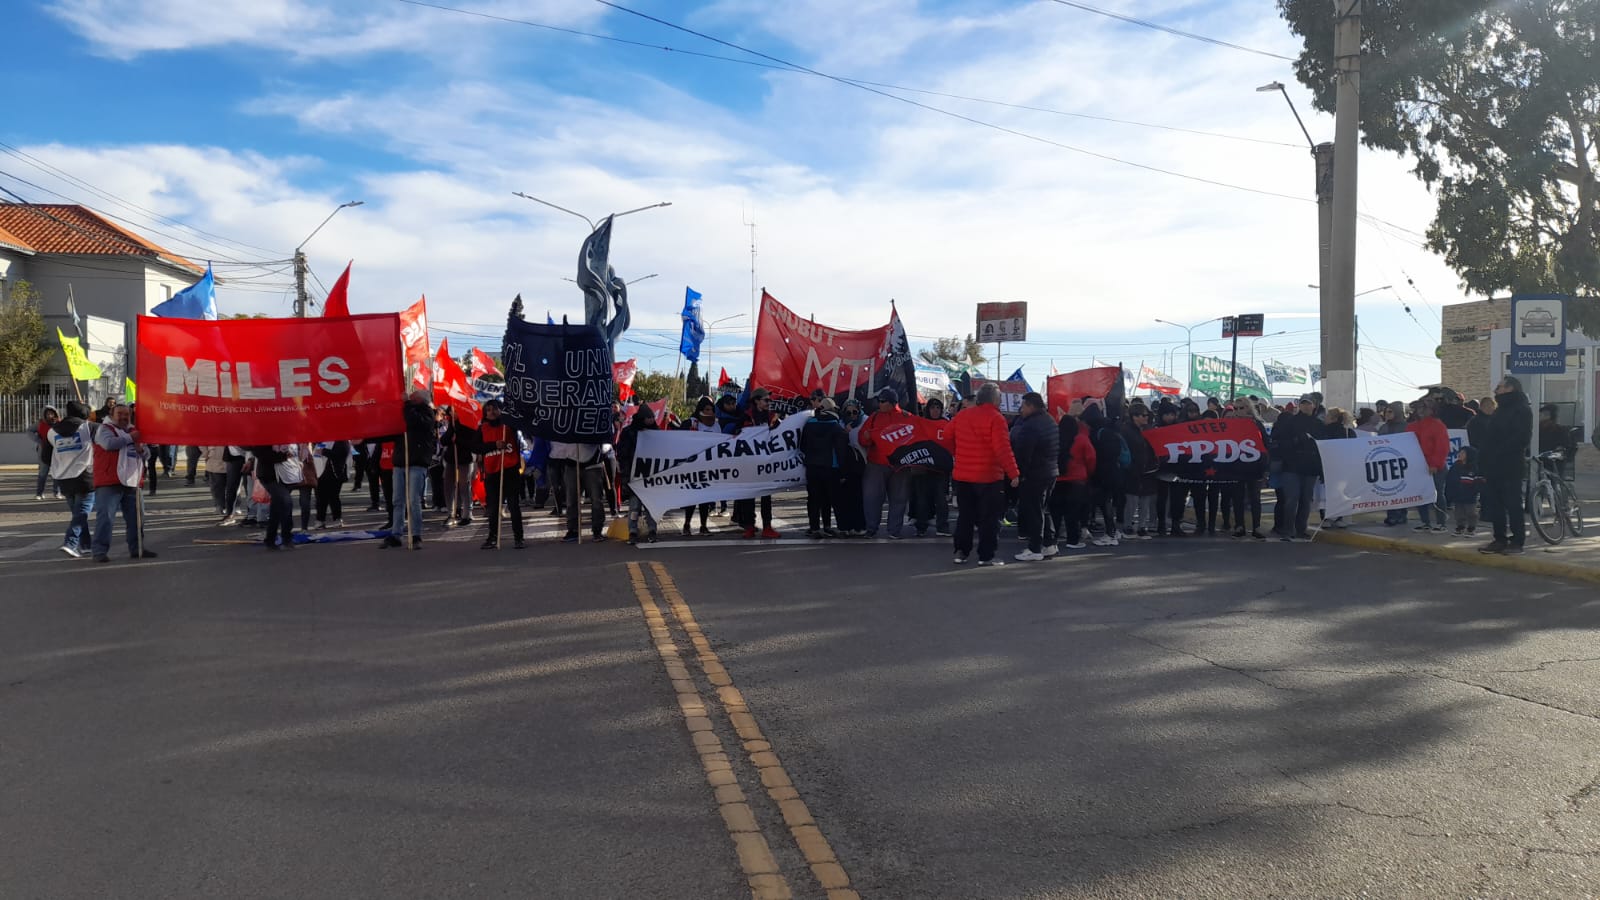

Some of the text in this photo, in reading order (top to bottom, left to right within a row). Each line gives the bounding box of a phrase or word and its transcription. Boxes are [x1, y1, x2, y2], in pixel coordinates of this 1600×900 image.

[764, 299, 840, 347] CHUBUT
[1518, 351, 1558, 359] EXCLUSIVO
[802, 346, 891, 401] MTL
[1188, 421, 1228, 434] UTEP
[900, 448, 930, 465] PUERTO
[1164, 439, 1261, 463] FPDS
[643, 468, 740, 489] MOVIMIENTO
[1365, 457, 1409, 484] UTEP
[1352, 500, 1388, 510] PUERTO
